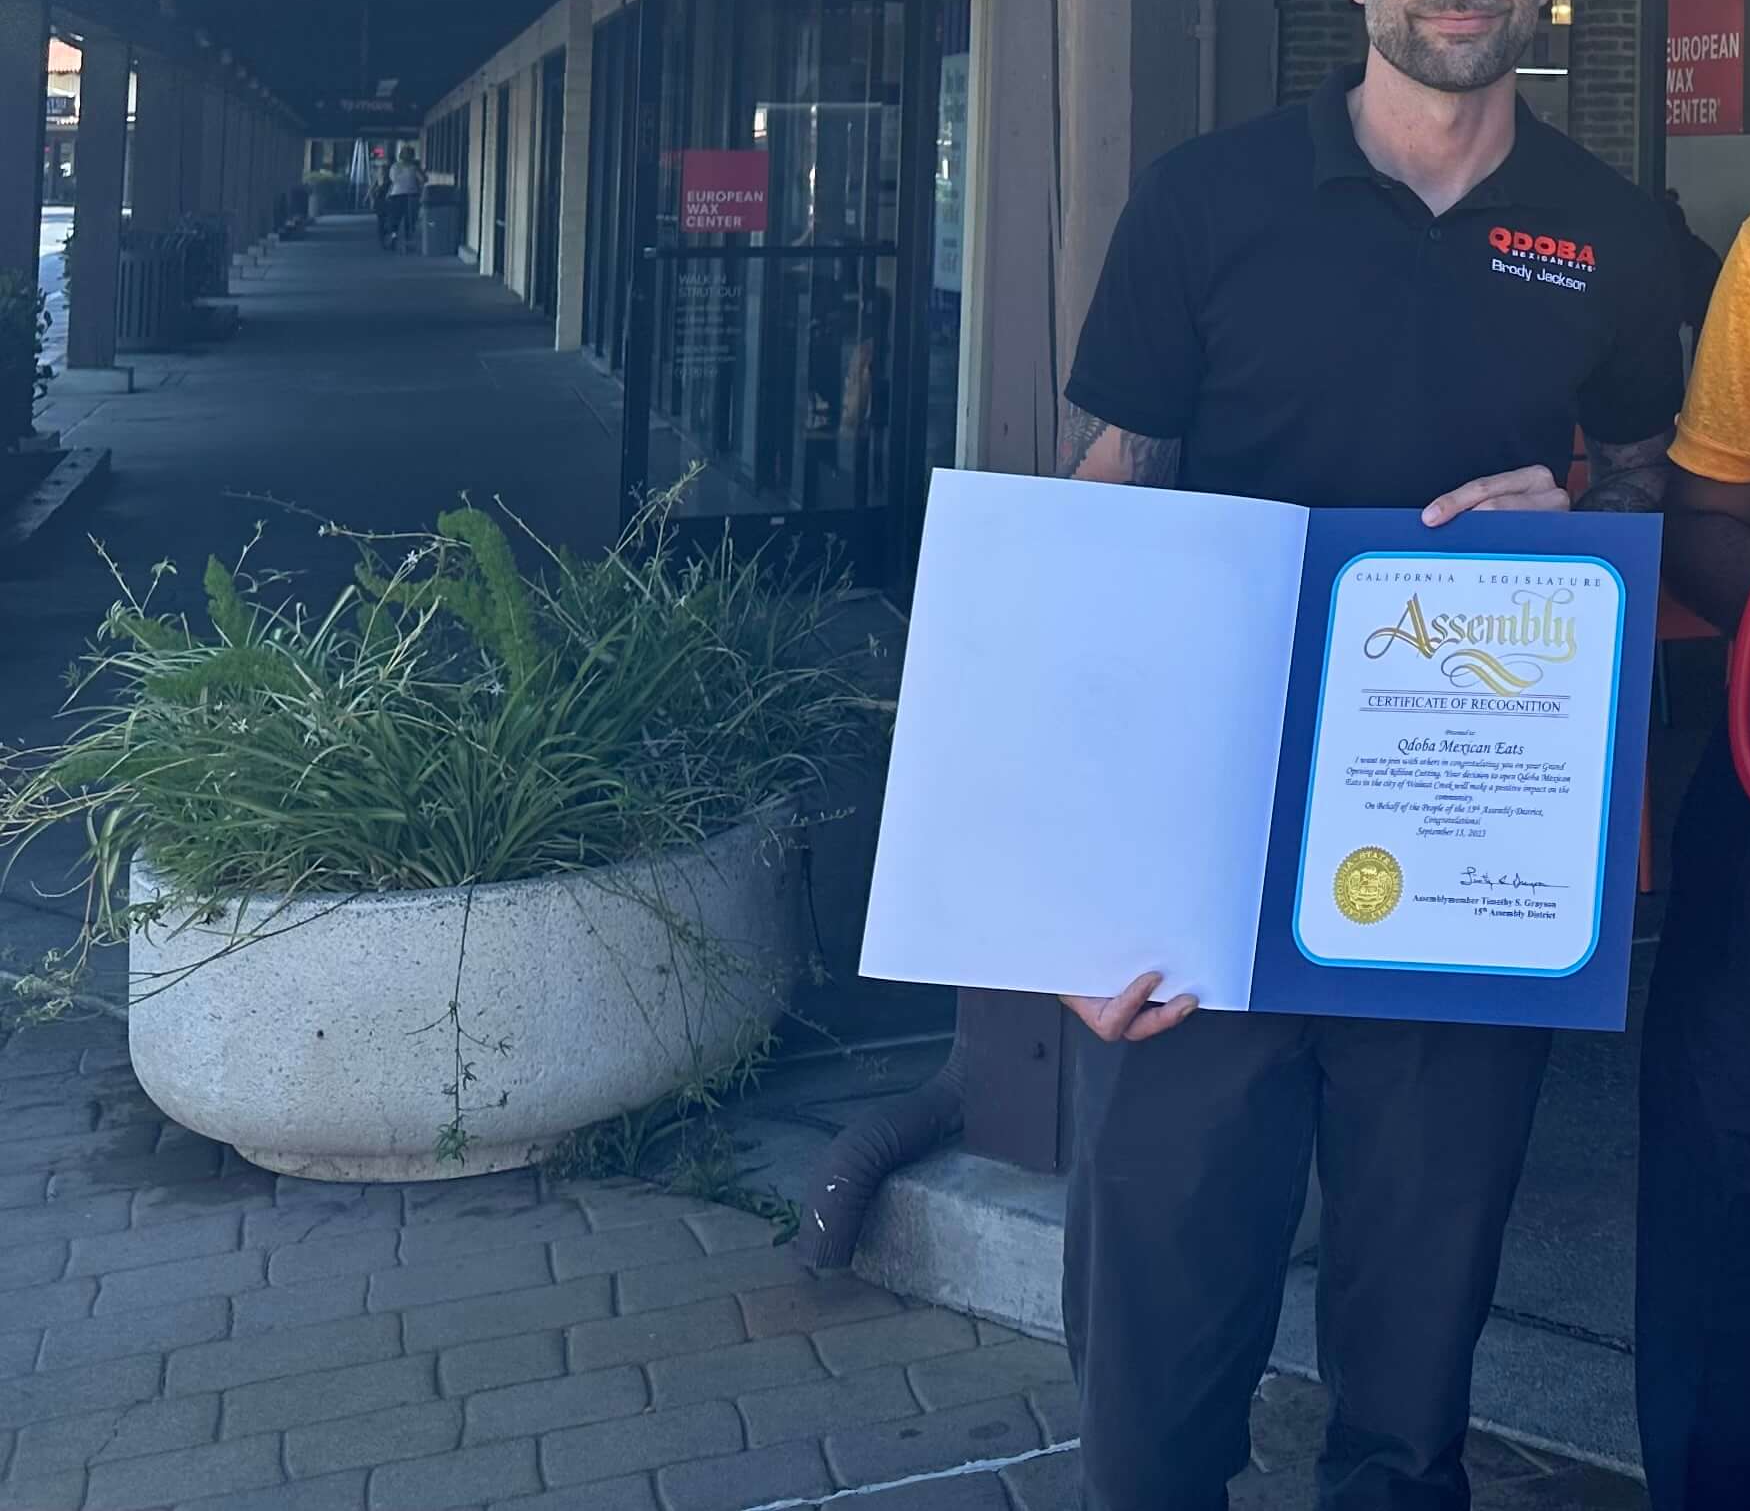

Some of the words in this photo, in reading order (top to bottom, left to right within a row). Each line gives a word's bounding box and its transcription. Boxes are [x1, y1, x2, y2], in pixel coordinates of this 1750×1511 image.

[687, 191, 764, 202] EUROPEAN
[687, 203, 719, 215] WAX
[686, 215, 742, 228] CENTER
[1489, 226, 1596, 266] QDOBA
[1512, 249, 1563, 266] MEXICAN
[1491, 258, 1532, 282] Brody
[1537, 268, 1587, 293] Jackson
[719, 286, 743, 297] OUT
[1356, 573, 1456, 585] CALIFORNIA
[1479, 574, 1602, 587] LEGISLATURE
[1364, 589, 1577, 663] Assembly
[1368, 695, 1448, 709] CERTIFICATE
[1450, 697, 1467, 709] OF
[1471, 698, 1561, 713] RECOGNITION
[1397, 737, 1437, 756] Qdoba
[1438, 740, 1491, 756] Mexican
[1495, 741, 1525, 755] Eats
